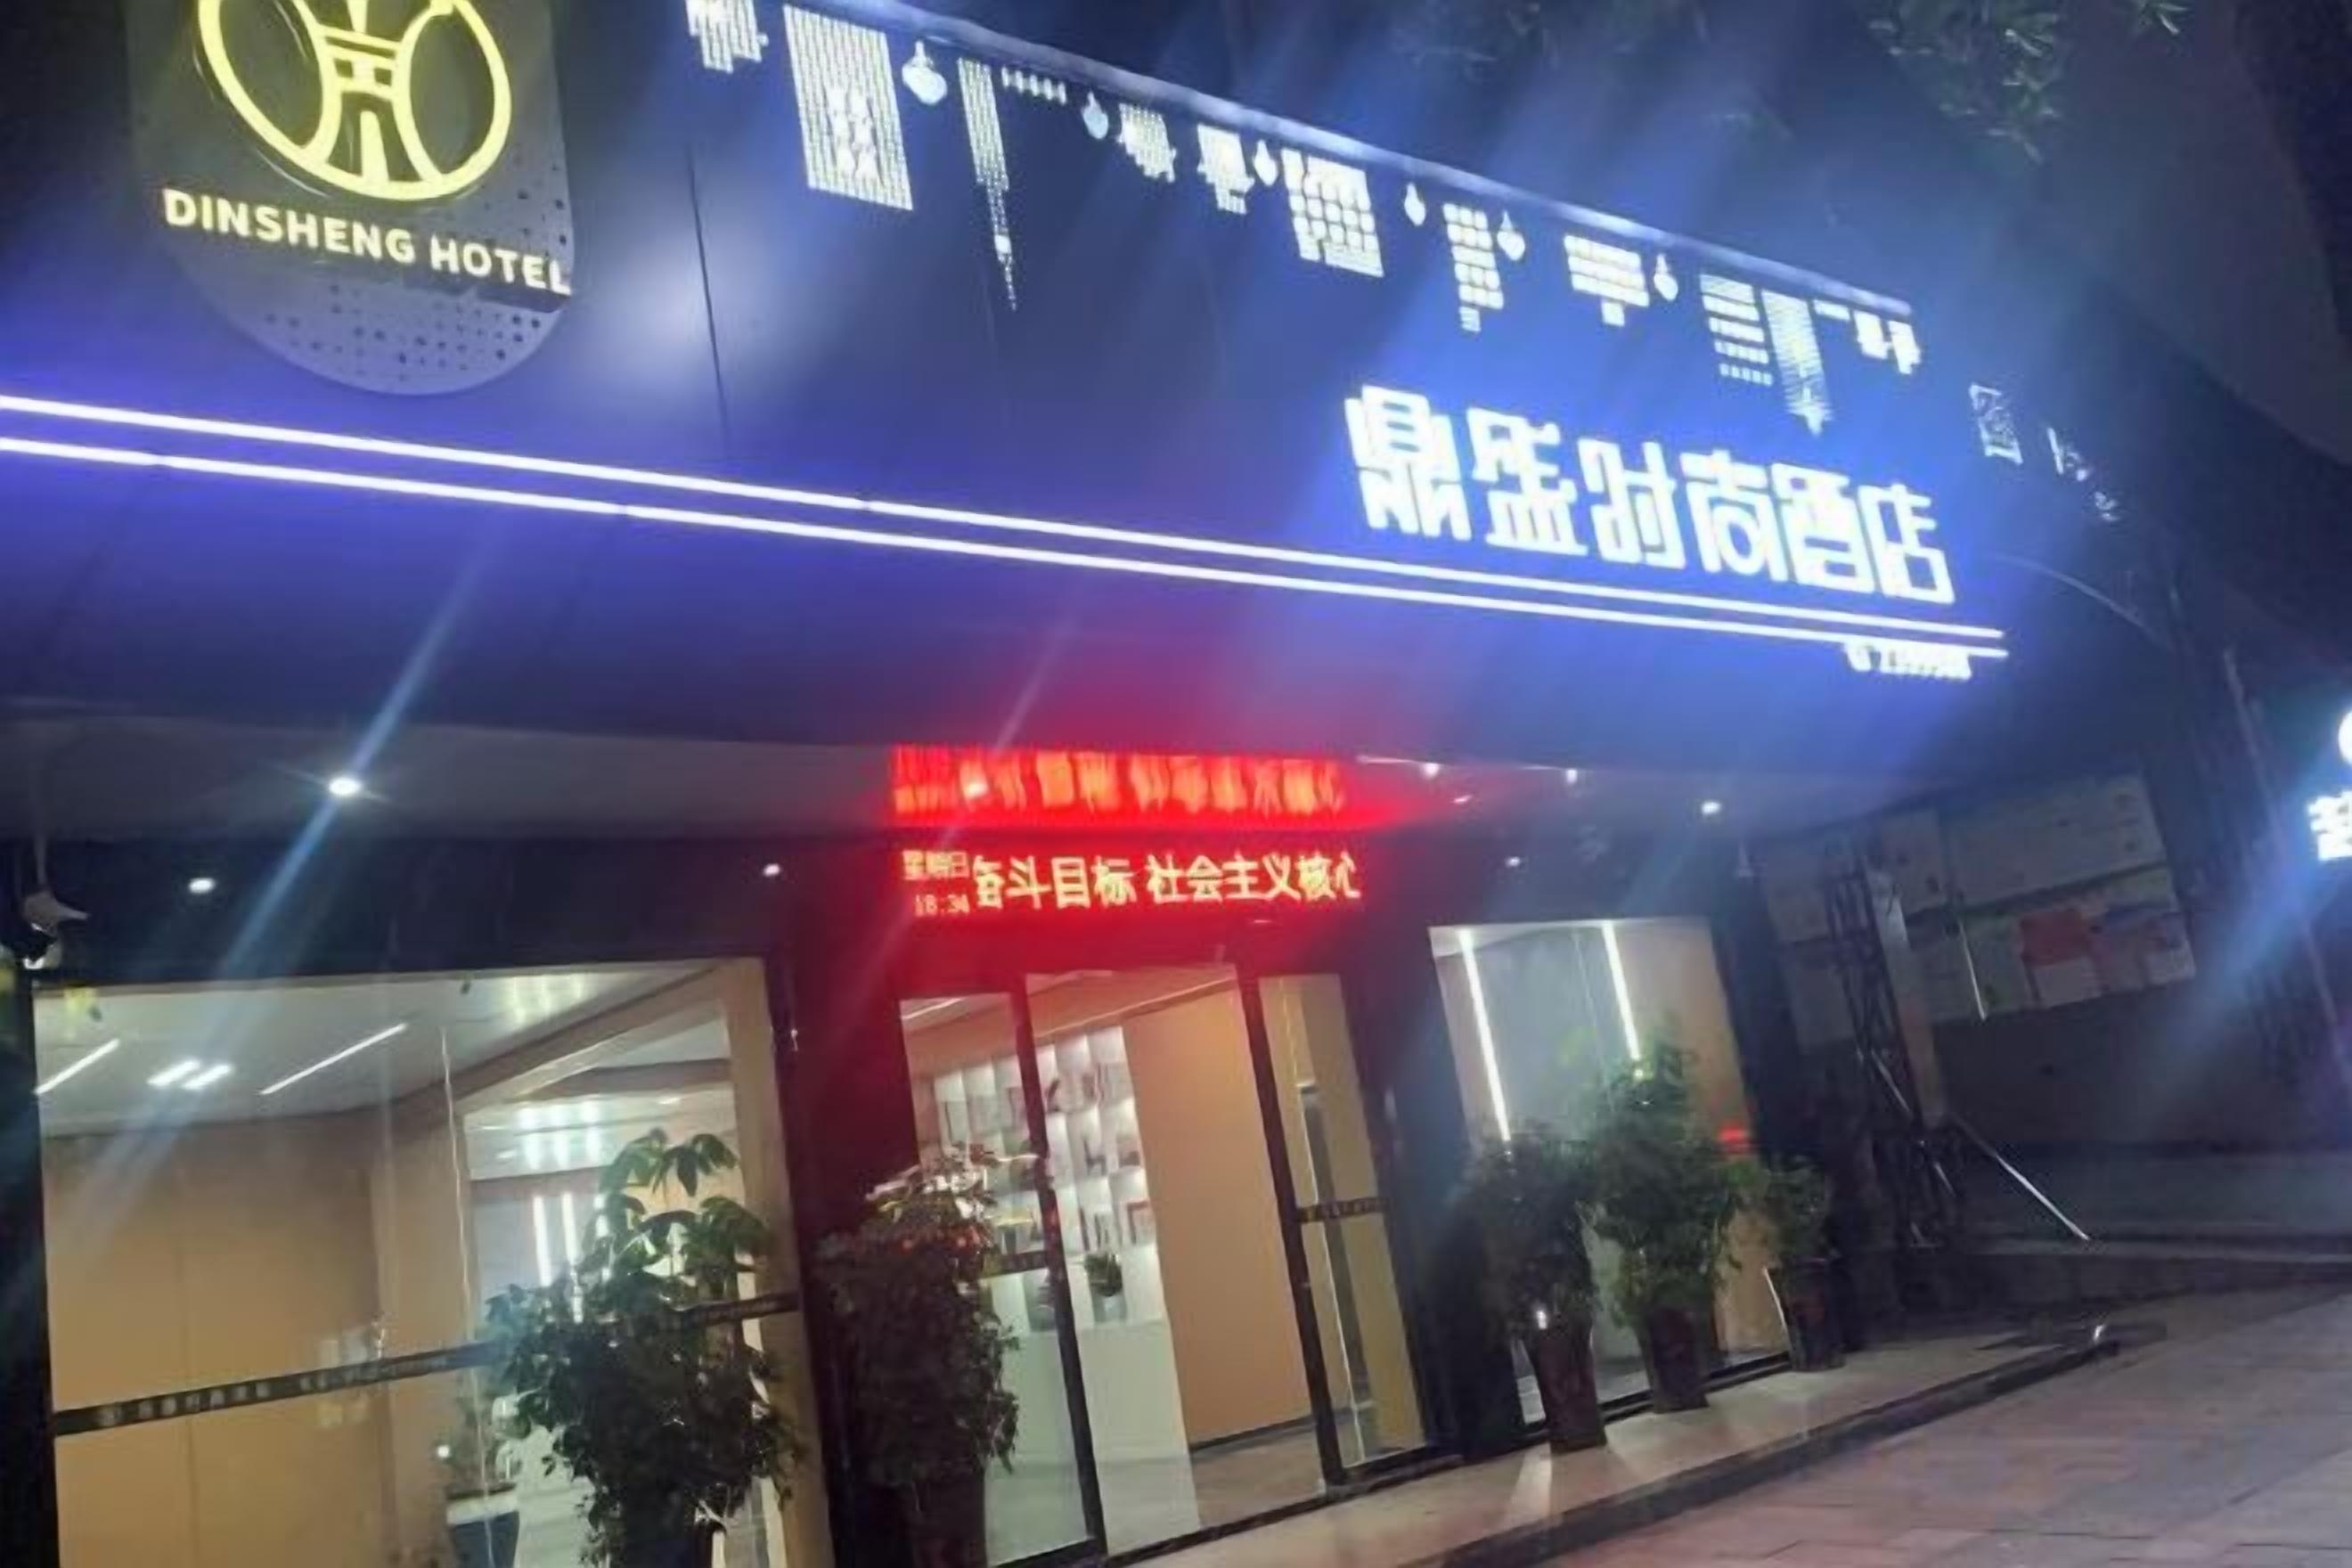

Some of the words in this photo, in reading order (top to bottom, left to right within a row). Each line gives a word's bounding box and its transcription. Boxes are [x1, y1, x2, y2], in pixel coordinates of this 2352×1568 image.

[162, 188, 416, 264] DINSHENG
[430, 233, 572, 296] HOTEL
[1343, 385, 1956, 604] 鼎盛时尚酒店
